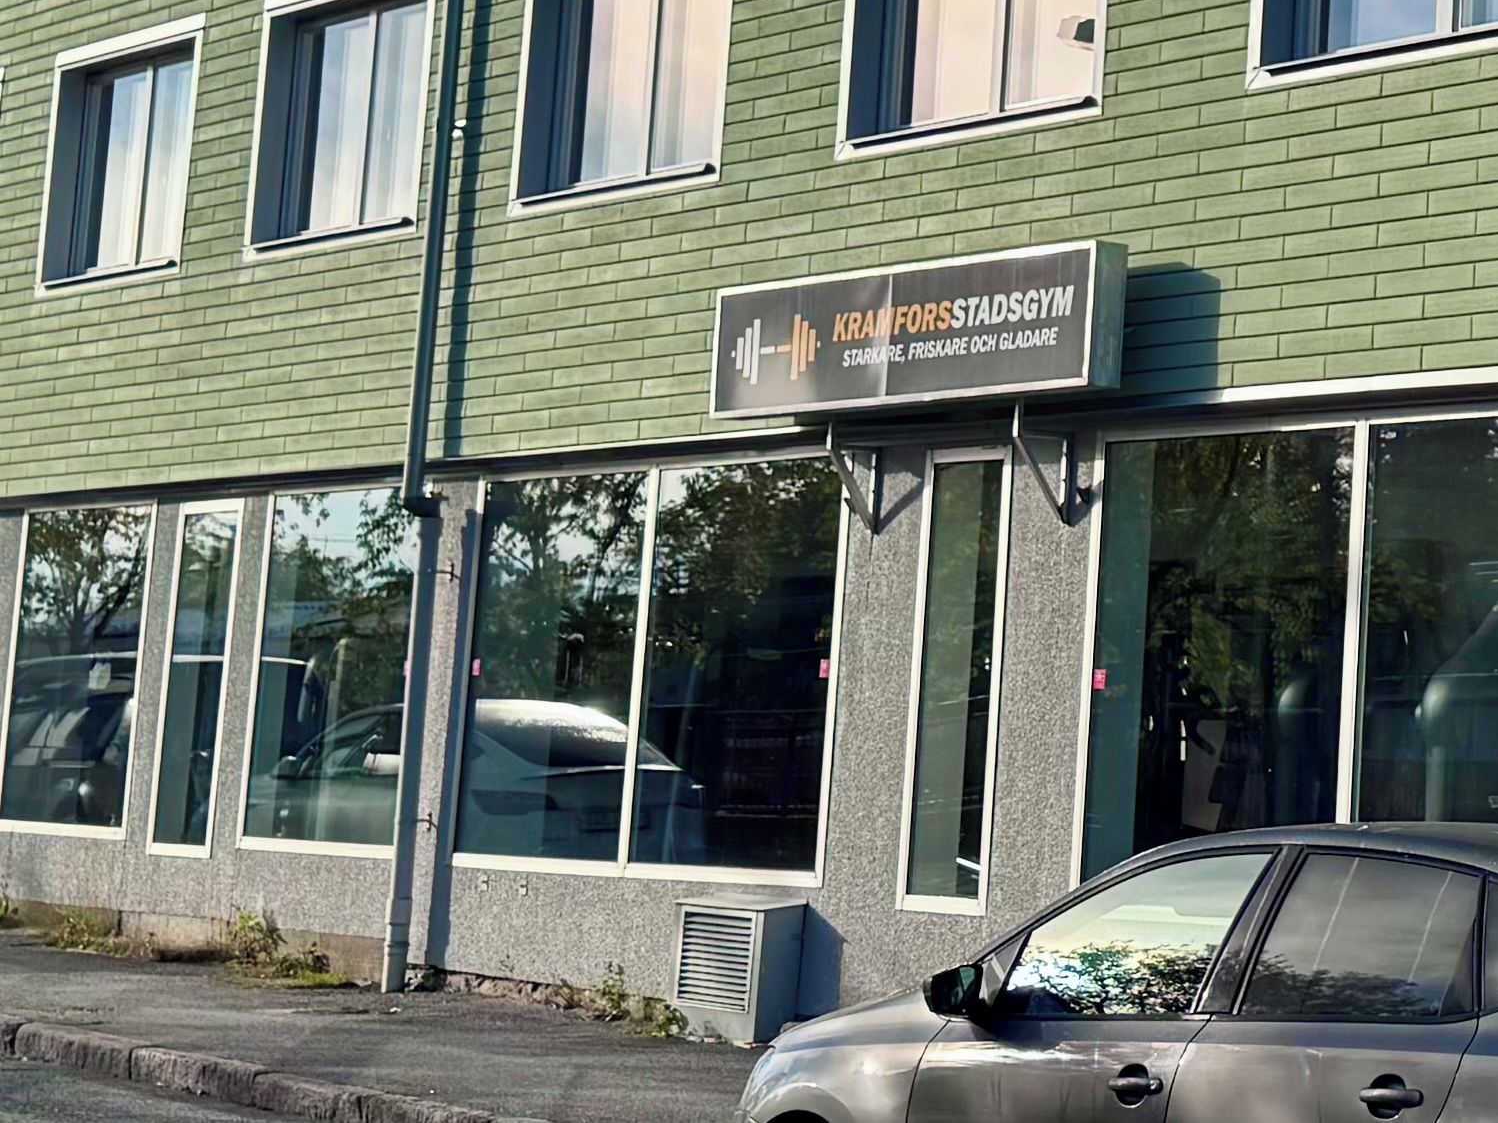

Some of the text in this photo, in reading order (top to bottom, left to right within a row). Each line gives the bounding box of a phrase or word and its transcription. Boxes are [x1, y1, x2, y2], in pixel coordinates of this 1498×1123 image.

[842, 326, 1059, 367] STARKARE, FRISKARE OCH GLADARE
